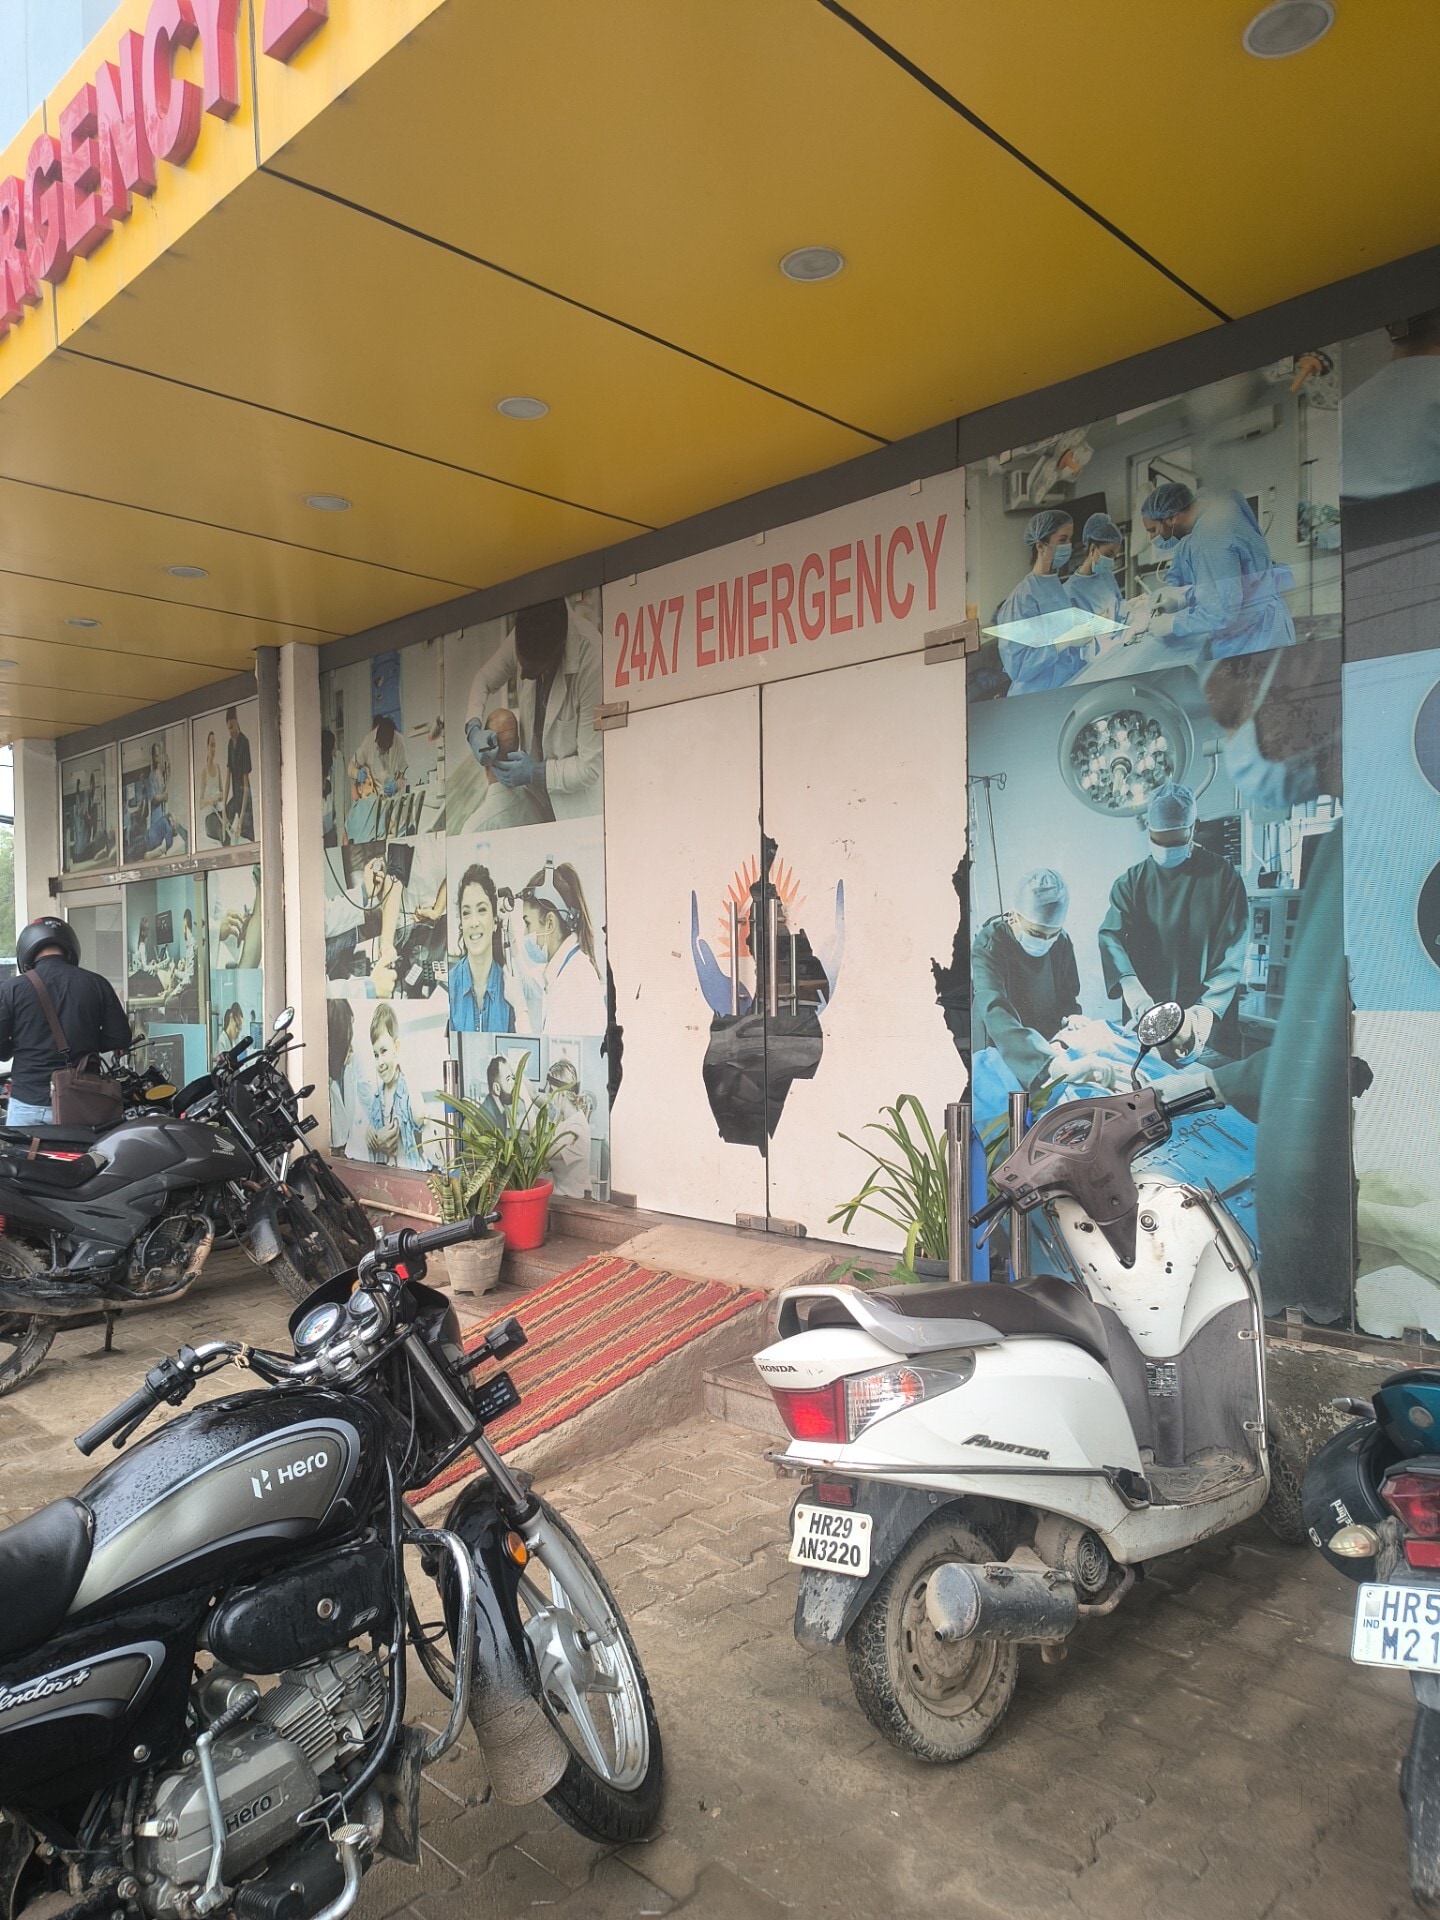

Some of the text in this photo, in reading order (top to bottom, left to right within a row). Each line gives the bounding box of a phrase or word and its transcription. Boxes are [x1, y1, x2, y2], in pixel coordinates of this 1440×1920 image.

[615, 514, 948, 687] 24X7 EMERGENCY
[758, 1364, 798, 1373] HONDA
[808, 1512, 853, 1539] HR29
[797, 1536, 862, 1568] AN3220
[1362, 1618, 1380, 1629] IND
[1381, 1626, 1440, 1664] M21
